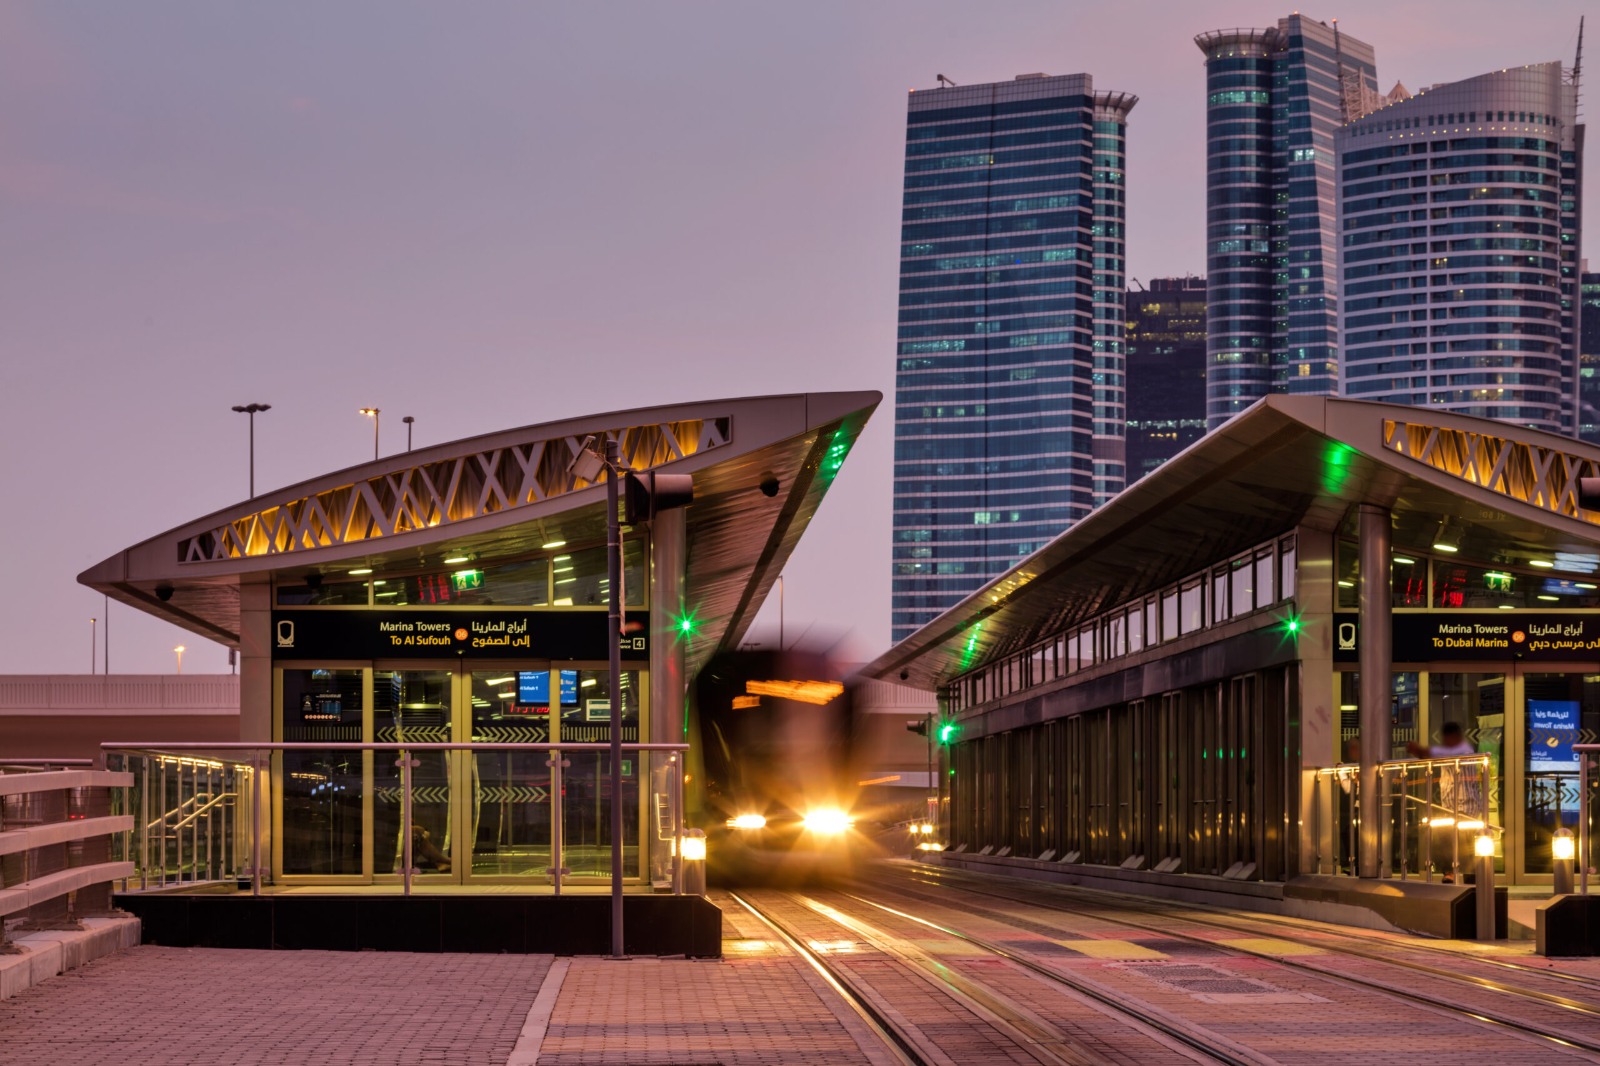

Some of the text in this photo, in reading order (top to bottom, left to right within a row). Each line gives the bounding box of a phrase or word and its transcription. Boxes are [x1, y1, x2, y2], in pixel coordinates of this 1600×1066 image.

[379, 622, 451, 632] Marina Towers
[471, 618, 527, 634] أبراج المارينا
[1439, 624, 1508, 634] Marina Towers
[1529, 621, 1583, 637] أبراج المارينا
[456, 630, 467, 639] 06
[390, 635, 451, 646] To Al Sufouh
[472, 635, 530, 648] إلى الصفوح
[636, 640, 642, 648] 4
[1432, 637, 1509, 648] To Dubai Marina
[1529, 637, 1600, 652] لى مرسى دبي
